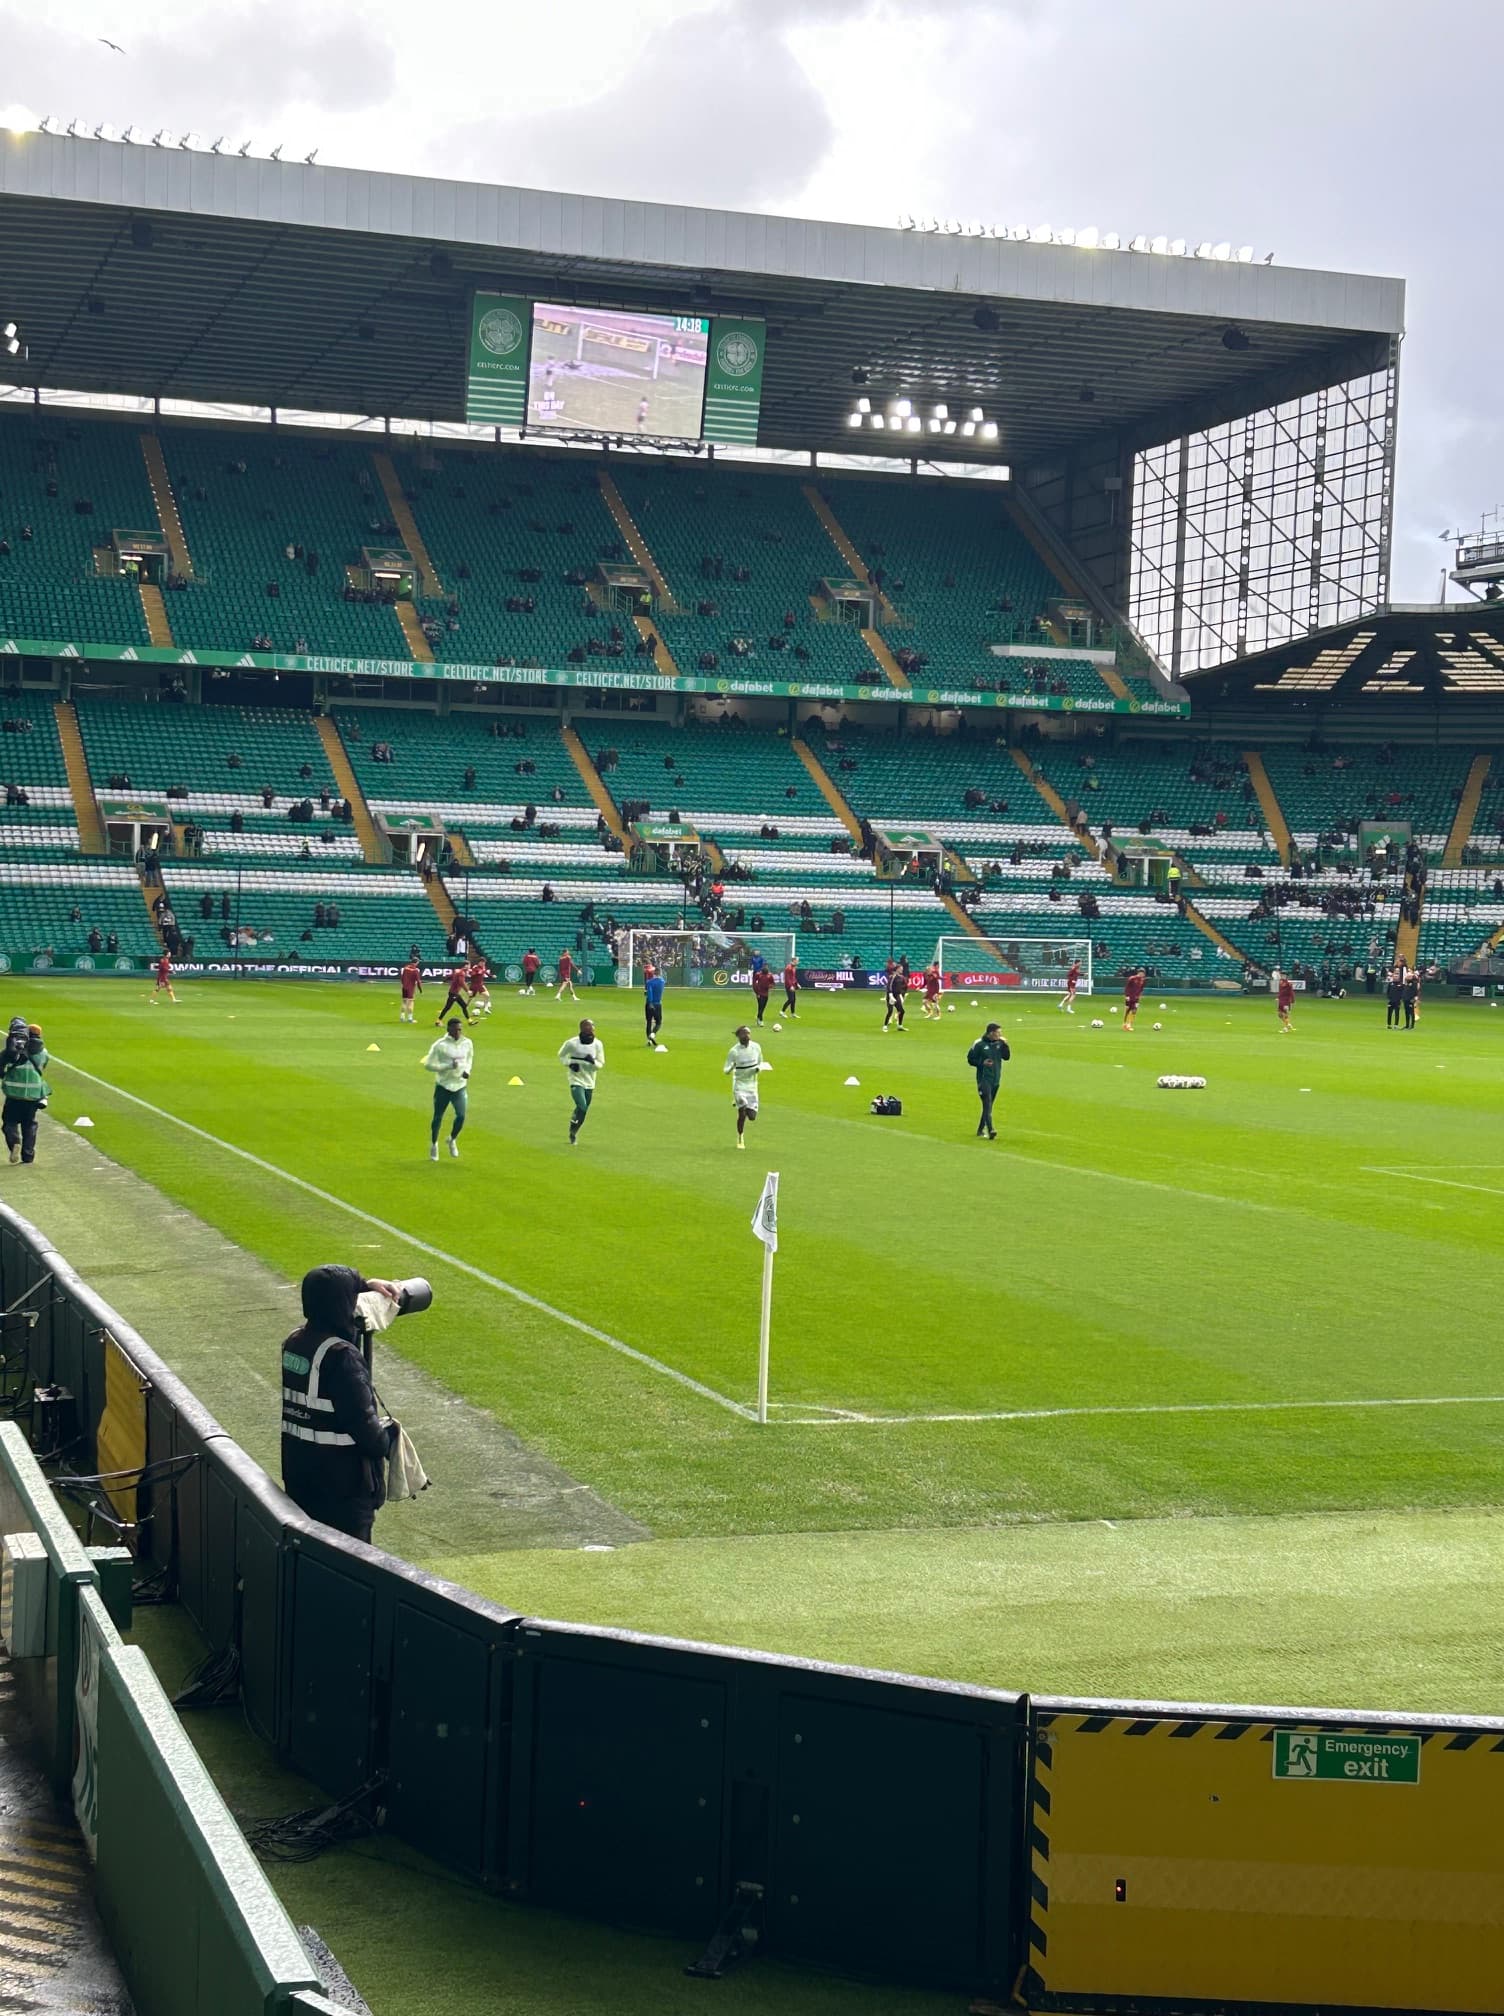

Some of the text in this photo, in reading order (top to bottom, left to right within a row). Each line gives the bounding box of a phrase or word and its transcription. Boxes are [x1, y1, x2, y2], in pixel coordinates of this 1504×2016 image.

[675, 316, 702, 333] 14:18
[476, 361, 520, 371] CELTICFC.COM
[306, 655, 415, 676] CELTICFC.NET/STORE
[443, 664, 548, 684] CELTICFC.NET/STORE
[575, 672, 677, 691] CELTICFC.NET/STORE
[730, 679, 774, 694] dafabet
[801, 683, 844, 698] dafabet
[871, 687, 914, 701] dafabet
[940, 690, 982, 705] dafabet
[1007, 694, 1049, 708] dafabet
[1074, 697, 1116, 711] dafabet
[1140, 700, 1181, 714] dafabet
[347, 966, 399, 977] CELTIC
[421, 967, 453, 977] APP
[730, 969, 786, 986] dafet
[836, 971, 854, 982] HILL
[1325, 1739, 1409, 1759] Emergency
[1343, 1757, 1389, 1778] exit
